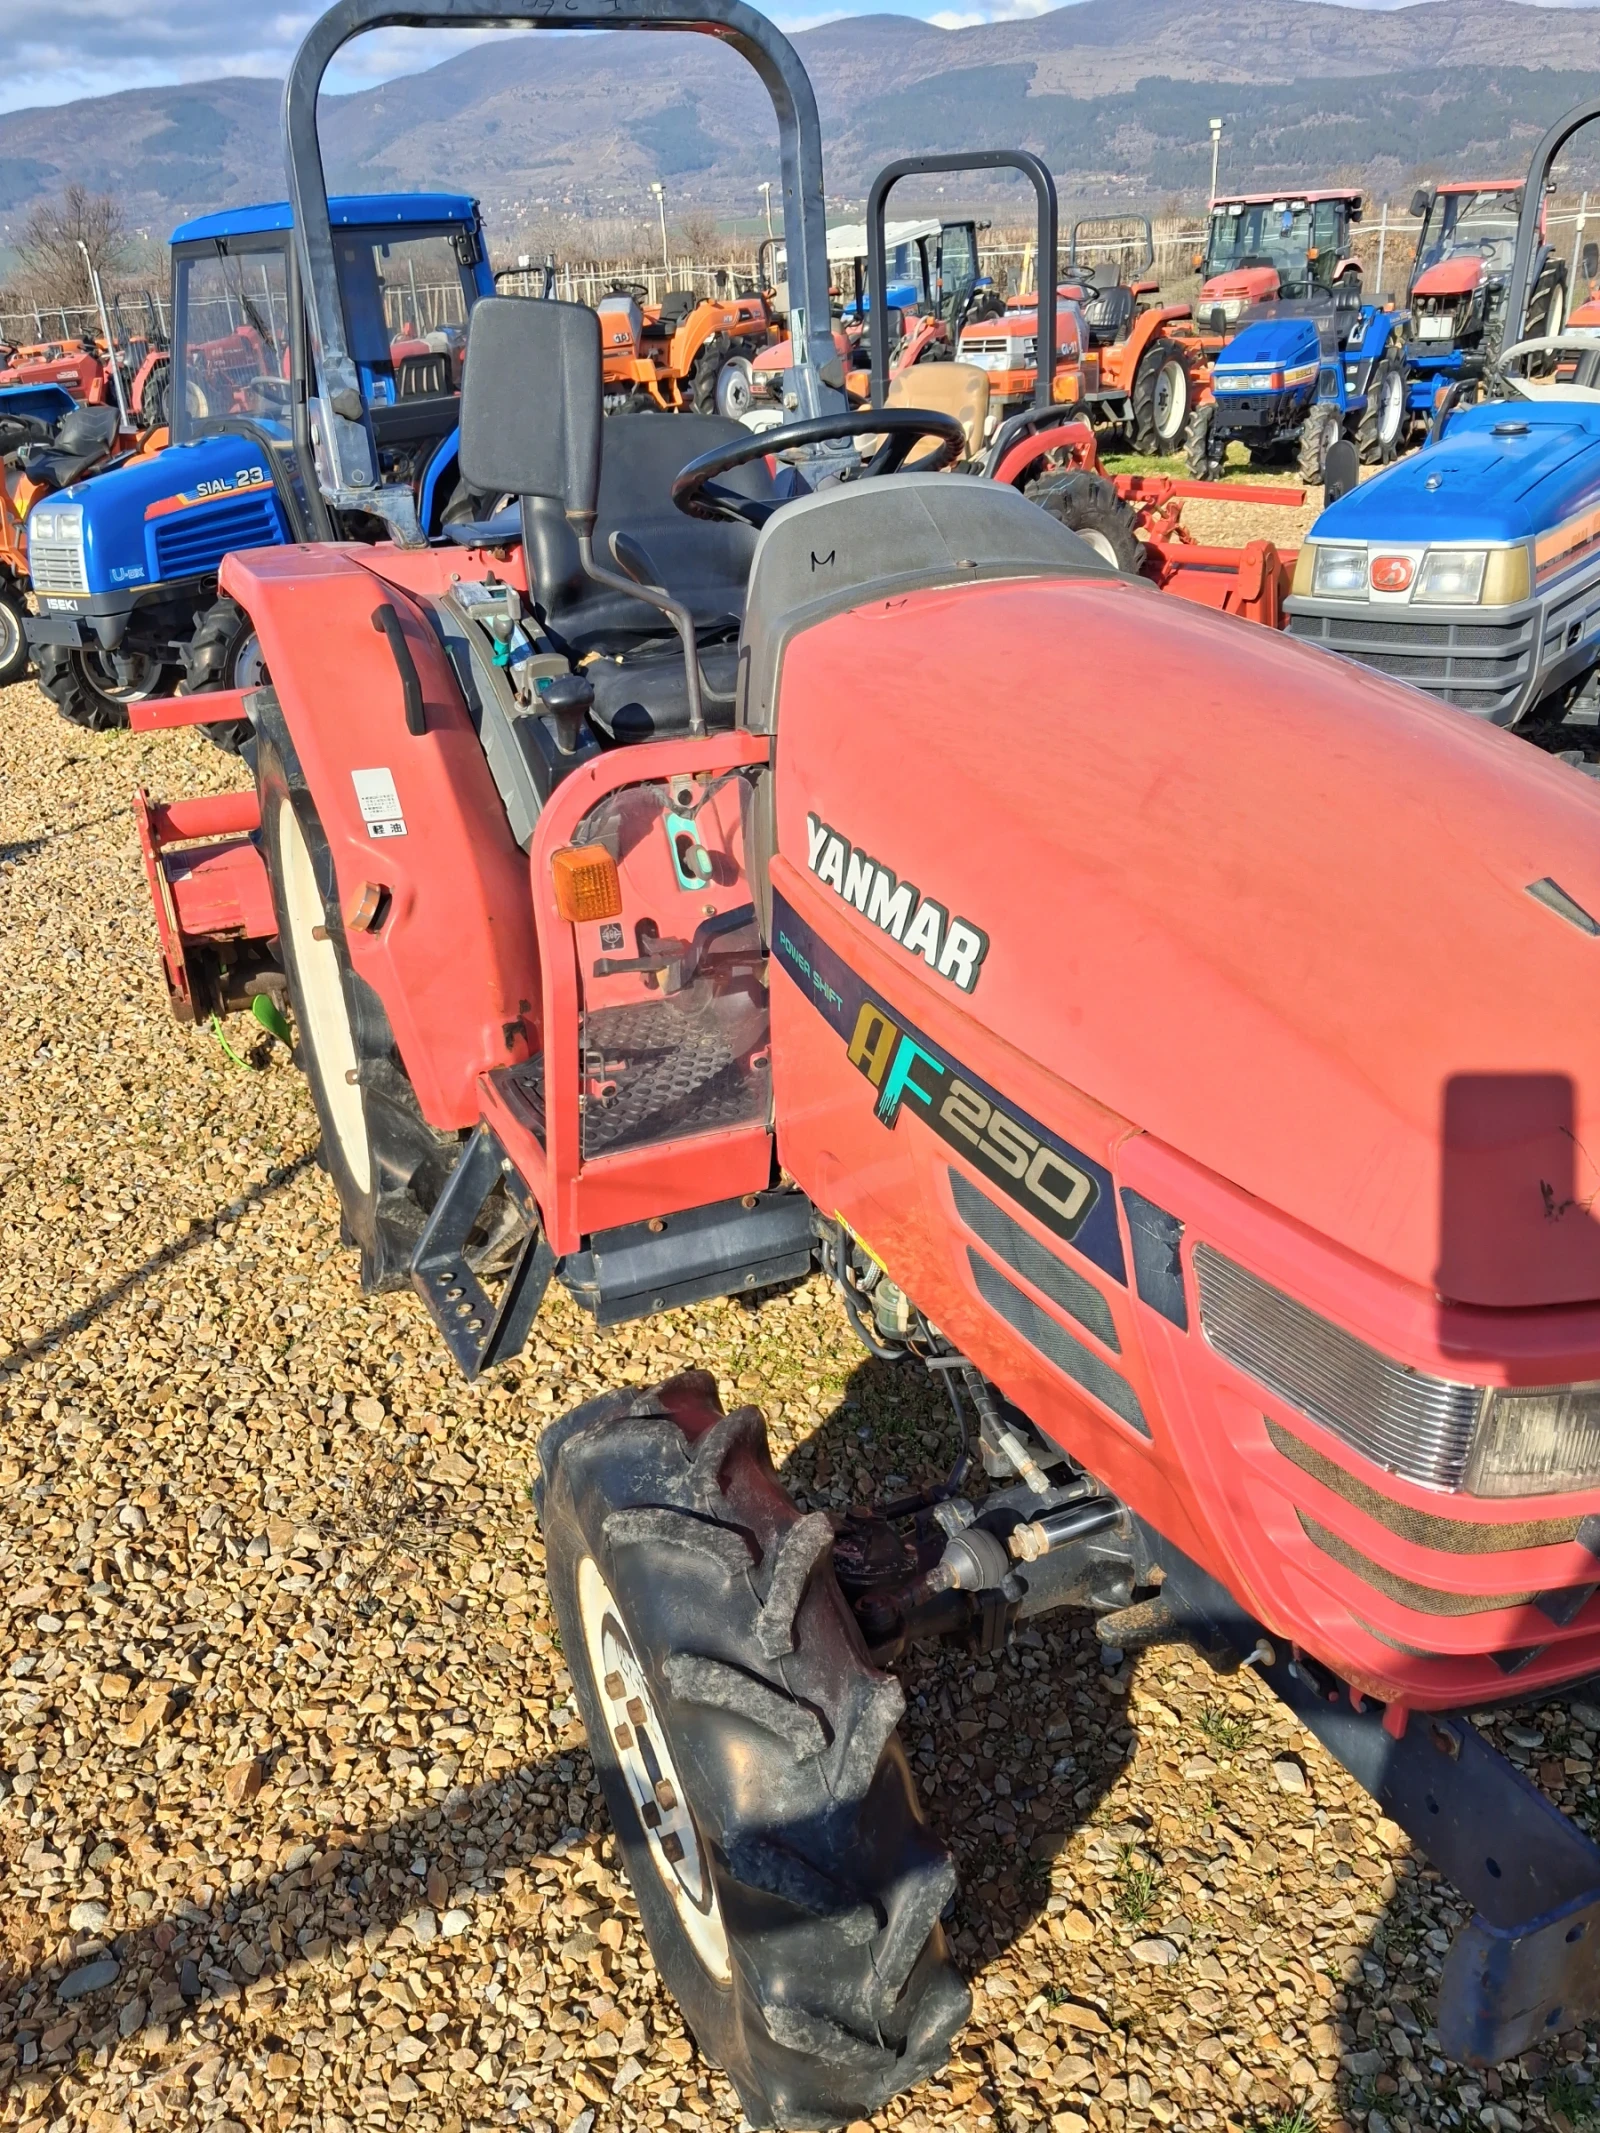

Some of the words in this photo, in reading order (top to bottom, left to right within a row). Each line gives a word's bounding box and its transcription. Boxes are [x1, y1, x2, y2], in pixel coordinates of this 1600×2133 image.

[196, 478, 232, 497] SIAL
[236, 466, 264, 486] 23
[46, 598, 79, 611] ISEKI
[372, 823, 402, 835] 軽油
[807, 811, 990, 994] YANMAR
[779, 930, 811, 978] POWER
[812, 970, 843, 1012] SHIFT
[847, 1001, 945, 1125] AF
[939, 1078, 1091, 1220] 250
